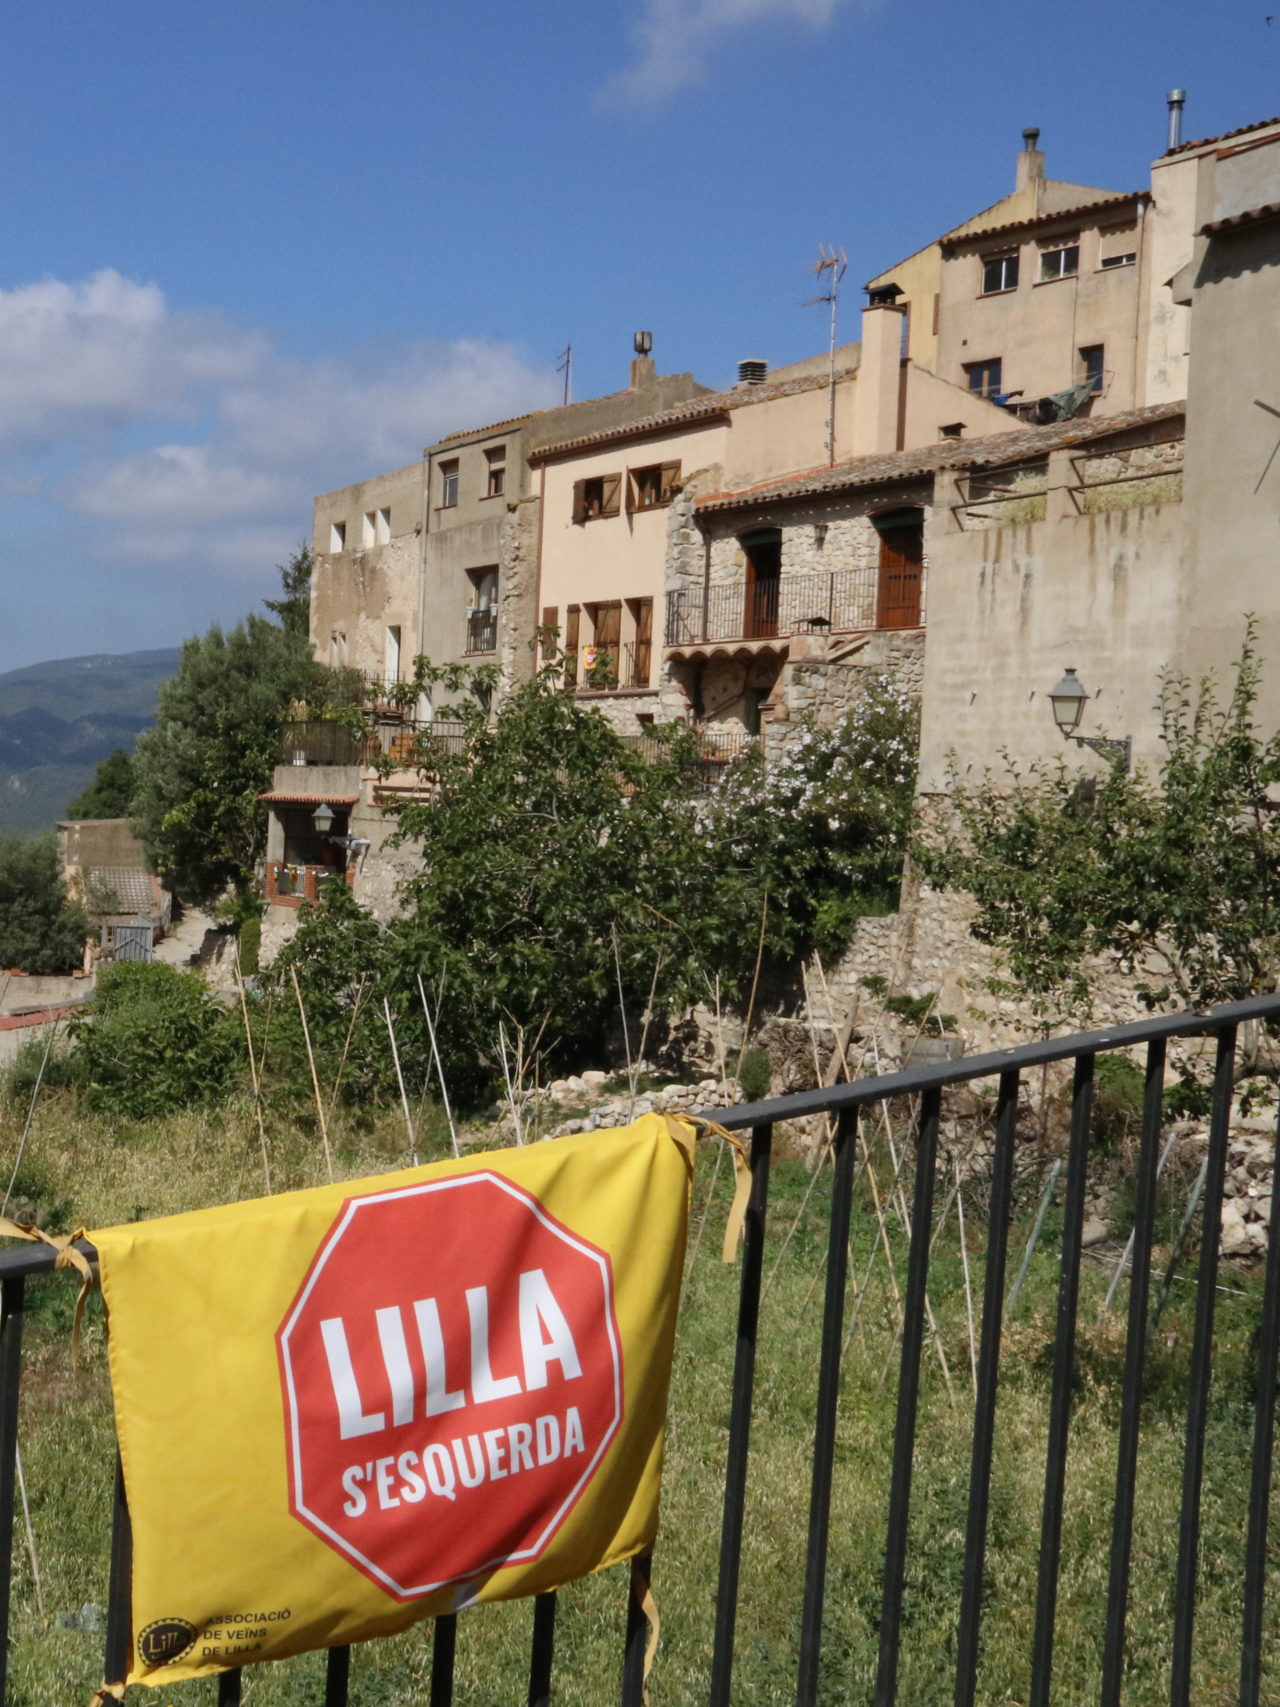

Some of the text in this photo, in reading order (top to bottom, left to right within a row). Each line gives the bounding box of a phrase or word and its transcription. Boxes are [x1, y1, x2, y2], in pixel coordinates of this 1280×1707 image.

[320, 1268, 583, 1441] LILLA
[342, 1406, 586, 1518] S'ESQUERDA
[206, 1608, 291, 1625] ASSOCIACIÓ
[203, 1627, 267, 1640] DE VEÏNS
[202, 1646, 222, 1657] DE
